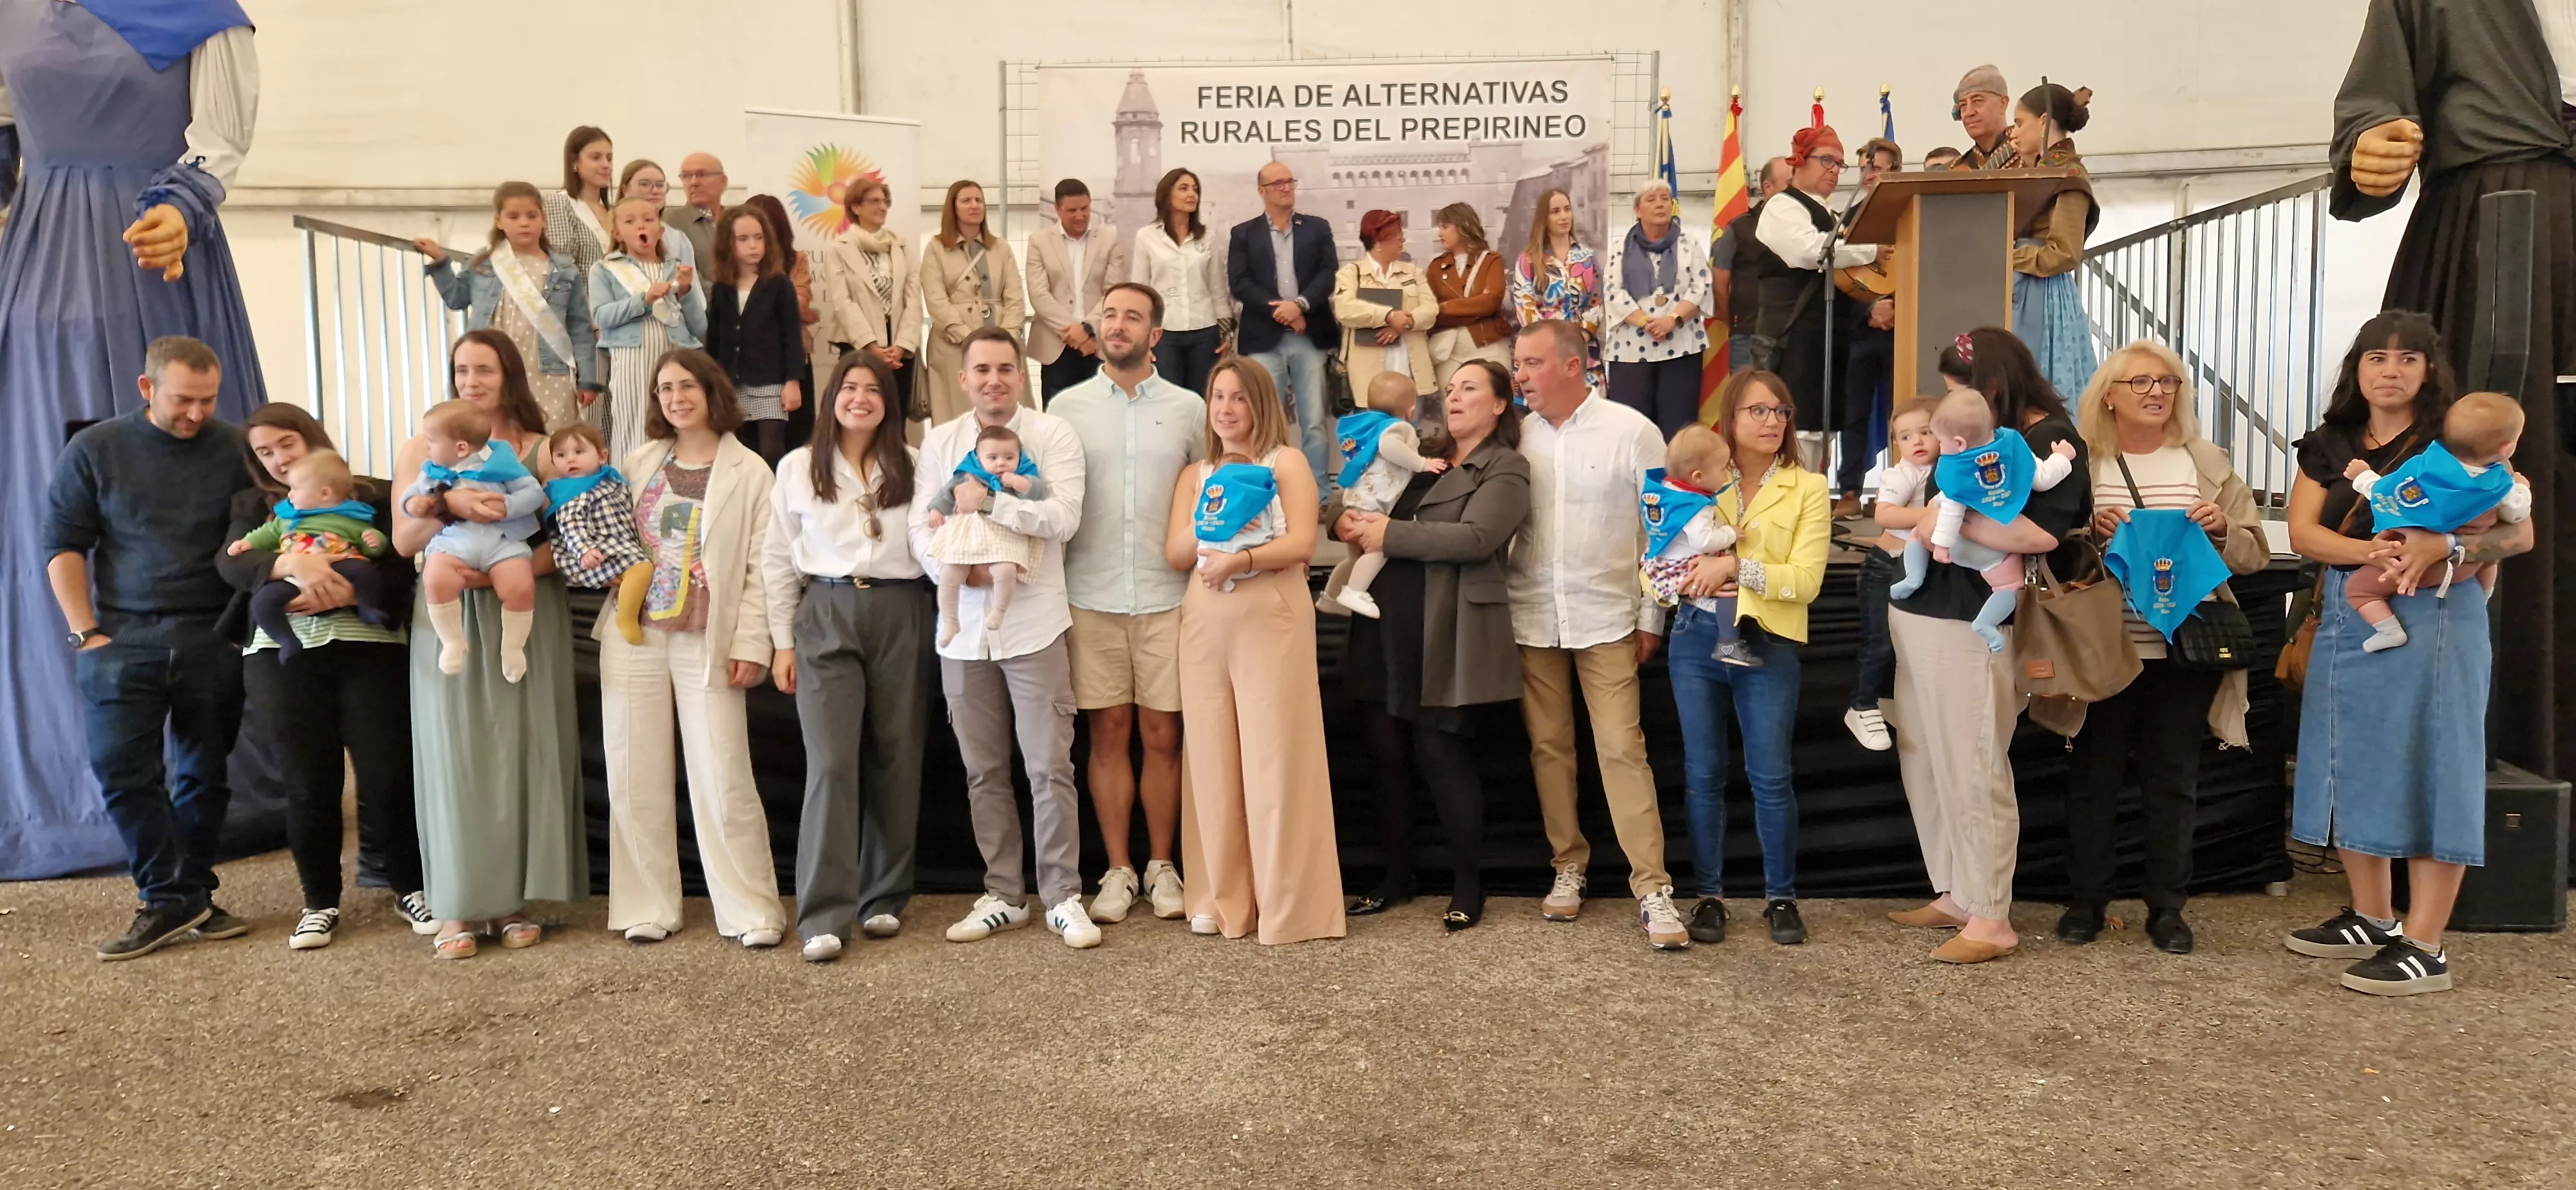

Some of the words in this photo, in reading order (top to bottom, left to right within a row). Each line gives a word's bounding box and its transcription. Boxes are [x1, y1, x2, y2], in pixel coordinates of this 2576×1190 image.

[1197, 85, 1285, 109] FERIA
[1294, 84, 1333, 108] DE
[1342, 80, 1569, 107] ALTERNATIVAS
[1180, 119, 1322, 144] RURALES
[1333, 118, 1391, 142] DEL
[1401, 114, 1586, 140] PREPIRINEO
